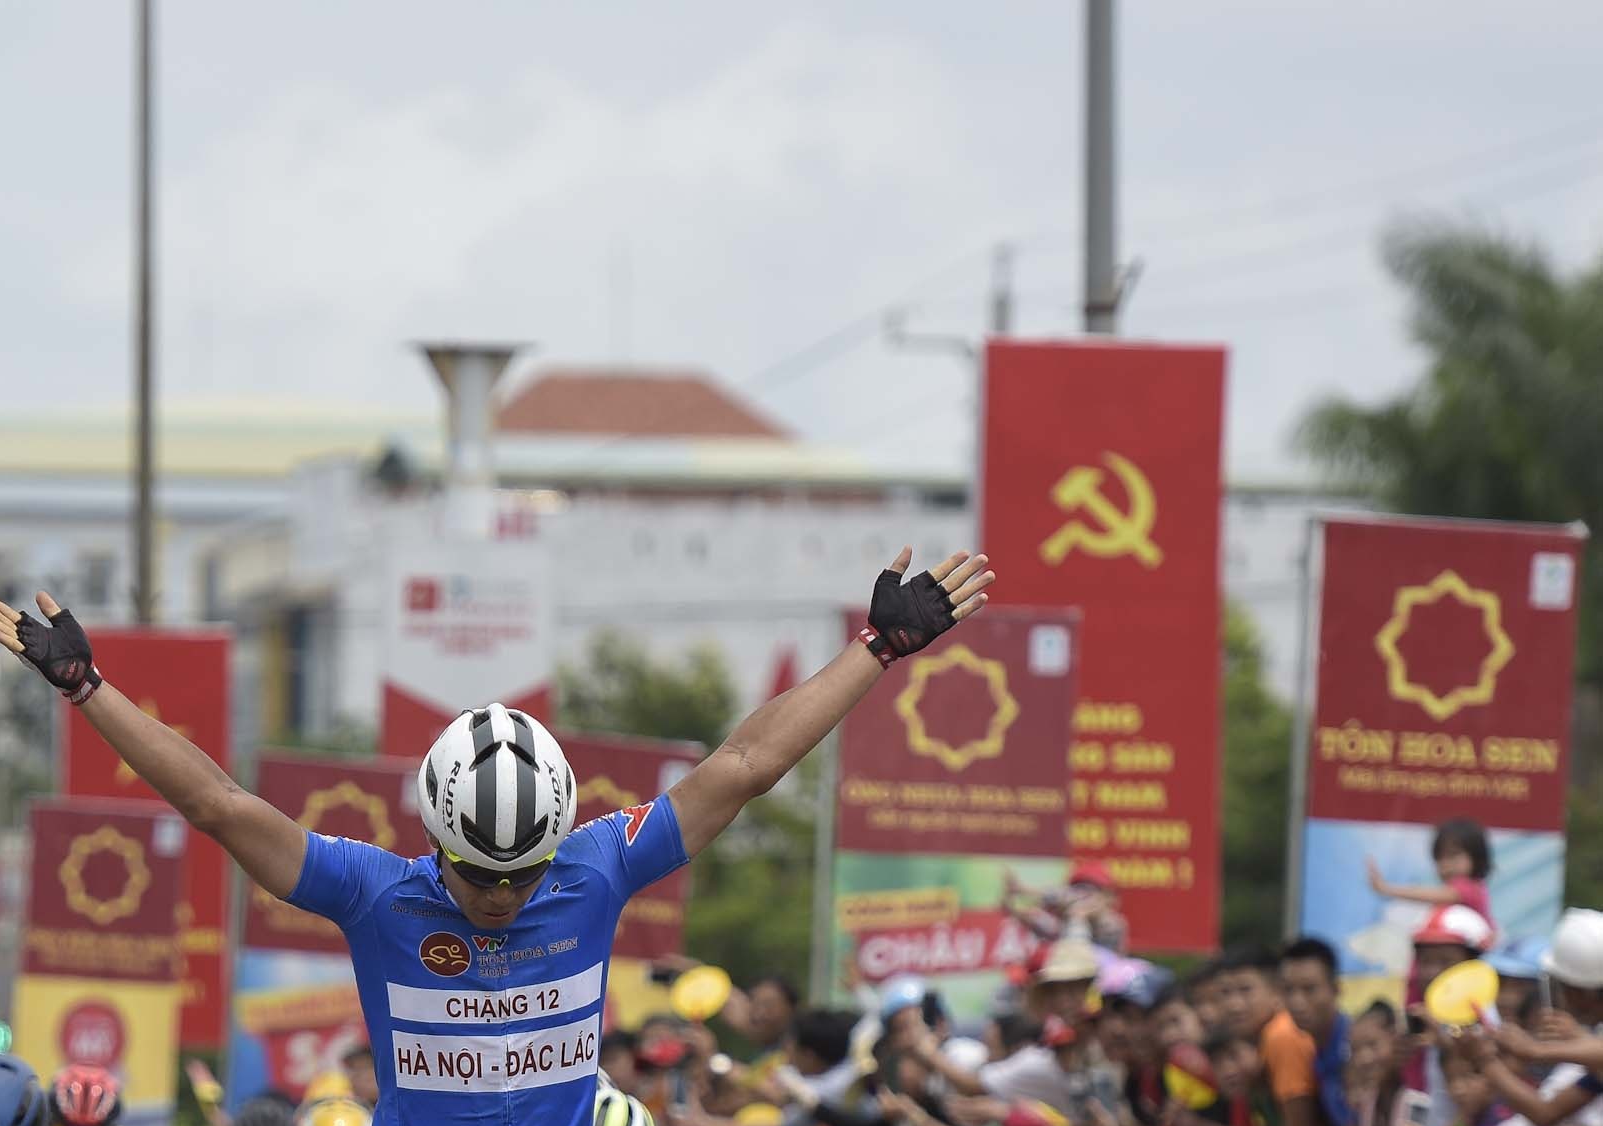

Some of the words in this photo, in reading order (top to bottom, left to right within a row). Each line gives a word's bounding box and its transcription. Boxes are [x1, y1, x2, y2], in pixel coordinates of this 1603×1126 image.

[1398, 730, 1477, 769] HOA
[1482, 736, 1558, 774] SEN
[444, 760, 461, 836] RUDY
[544, 760, 565, 836] RUDY
[472, 934, 508, 952] VTV
[512, 946, 546, 961] HOA
[548, 937, 578, 954] SEN
[858, 918, 986, 981] CHÂU
[446, 989, 529, 1023] CHẶNG
[537, 988, 560, 1011] 12
[398, 1043, 430, 1076] HÀ
[438, 1047, 482, 1085] NỘI
[506, 1041, 553, 1077] ĐẮC
[560, 1030, 595, 1068] LẮC
